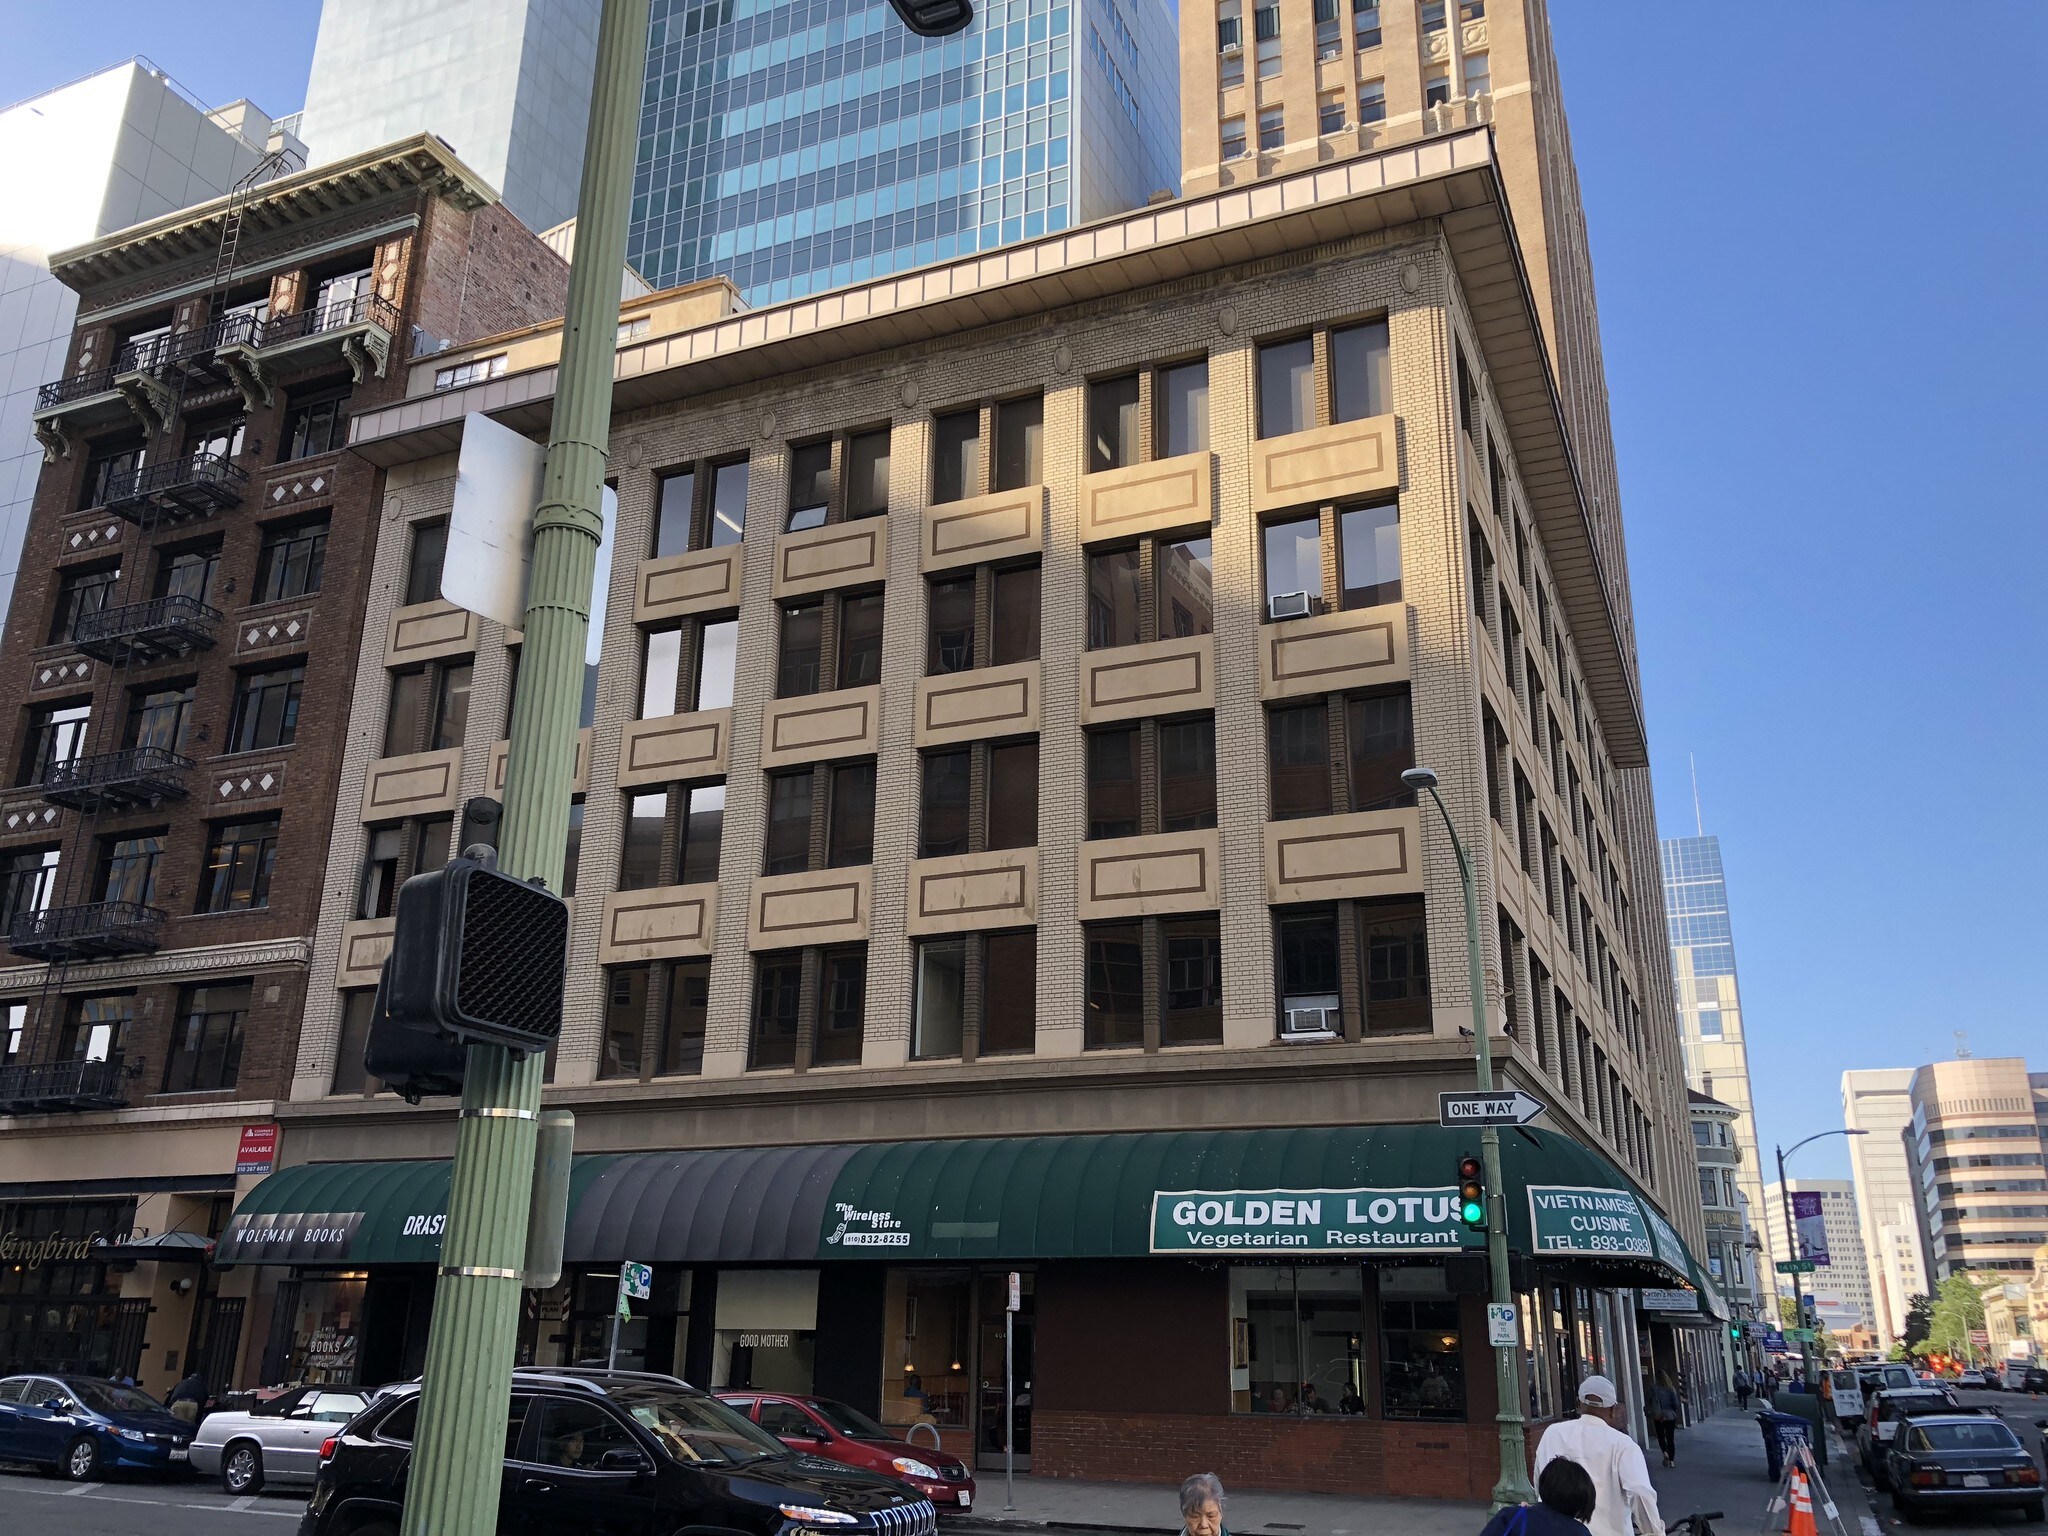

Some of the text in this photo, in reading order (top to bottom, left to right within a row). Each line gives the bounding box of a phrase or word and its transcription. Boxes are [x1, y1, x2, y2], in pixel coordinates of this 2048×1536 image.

[1452, 1102, 1514, 1116] ONE WAY
[835, 1203, 854, 1212] The
[1536, 1194, 1640, 1216] VIETNAMESE
[844, 1210, 891, 1221] Wireless
[1172, 1200, 1321, 1226] GOLDEN
[871, 1220, 901, 1228] Store
[1570, 1216, 1632, 1232] CUISINE
[115, 1233, 134, 1247] 414
[236, 1228, 345, 1242] WOLFMAN BOOKS
[1187, 1229, 1459, 1248] Vegetarian Restaurant
[0, 1231, 100, 1270] kingbird
[1544, 1235, 1651, 1253] TEL: 893-0383
[310, 1341, 341, 1353] BOOKS
[740, 1334, 789, 1347] GOOD MOTHER
